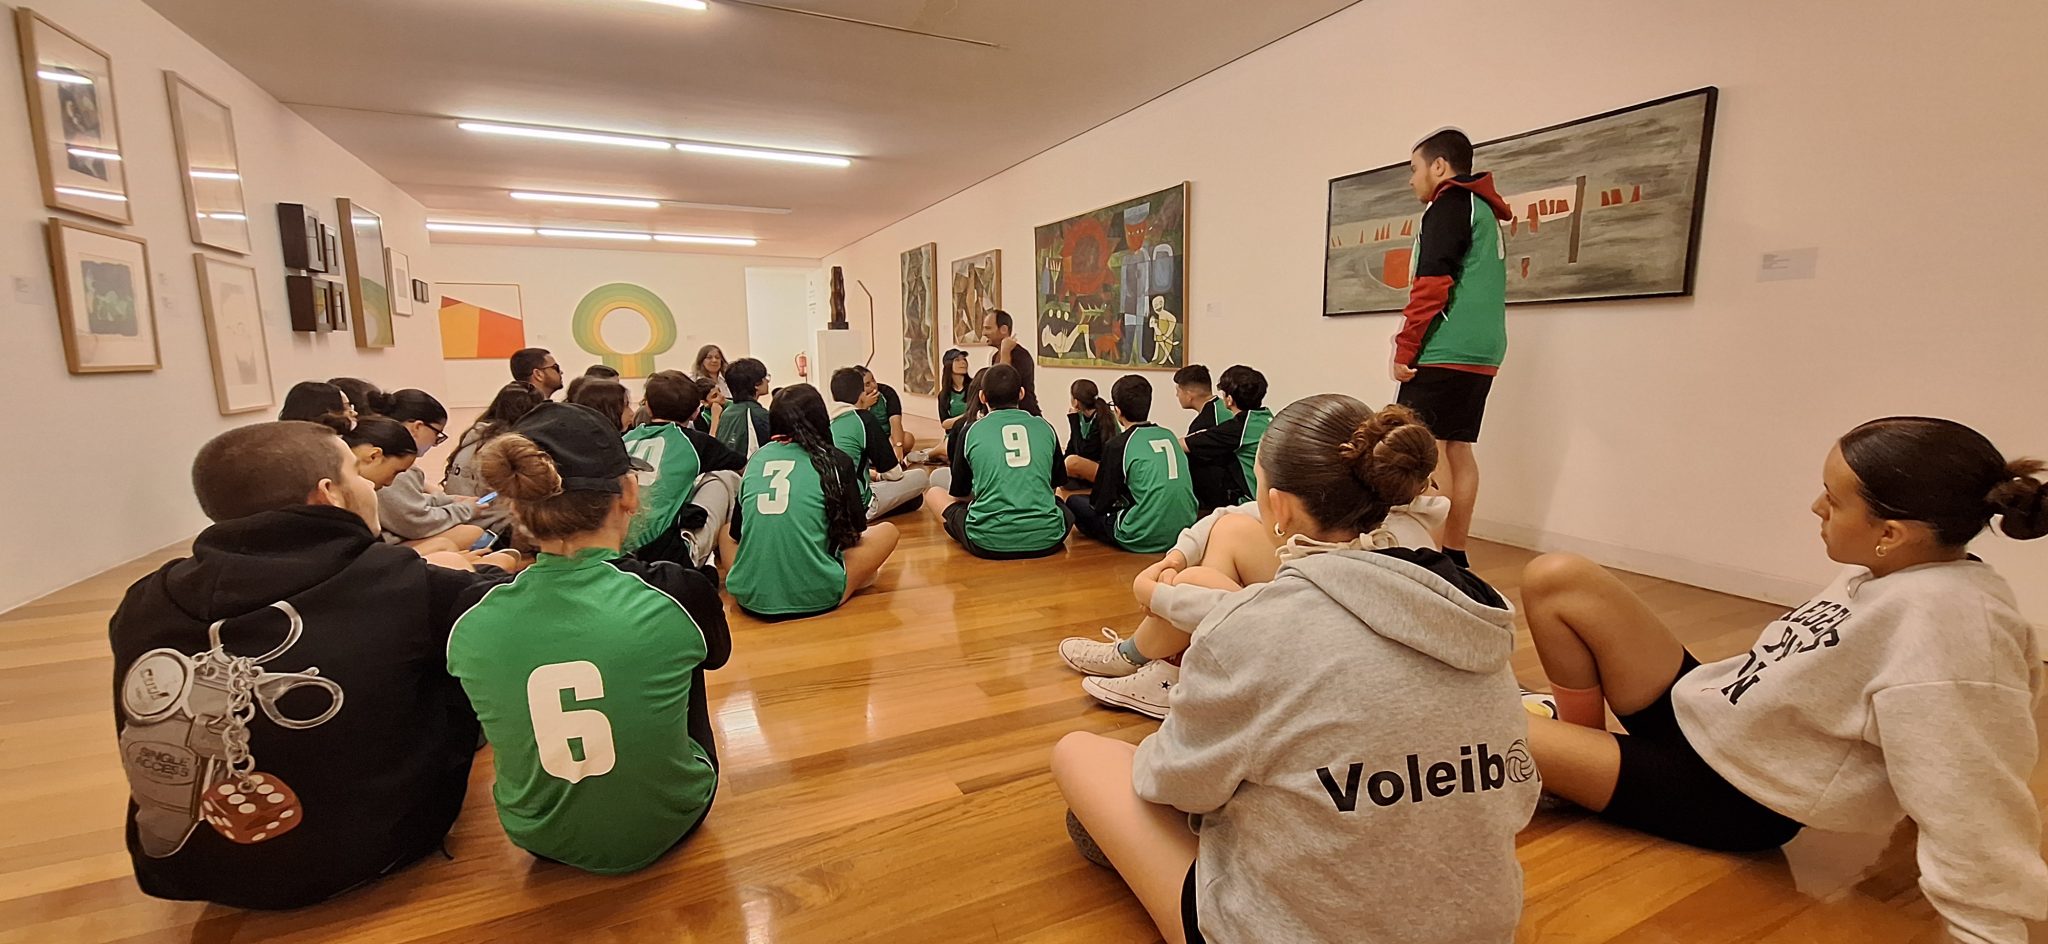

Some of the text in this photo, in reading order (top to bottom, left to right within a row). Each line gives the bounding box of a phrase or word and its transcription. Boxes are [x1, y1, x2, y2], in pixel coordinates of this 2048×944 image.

[1001, 424, 1031, 467] 9
[1149, 438, 1178, 480] 7
[757, 460, 796, 515] 3
[527, 660, 616, 784] 6
